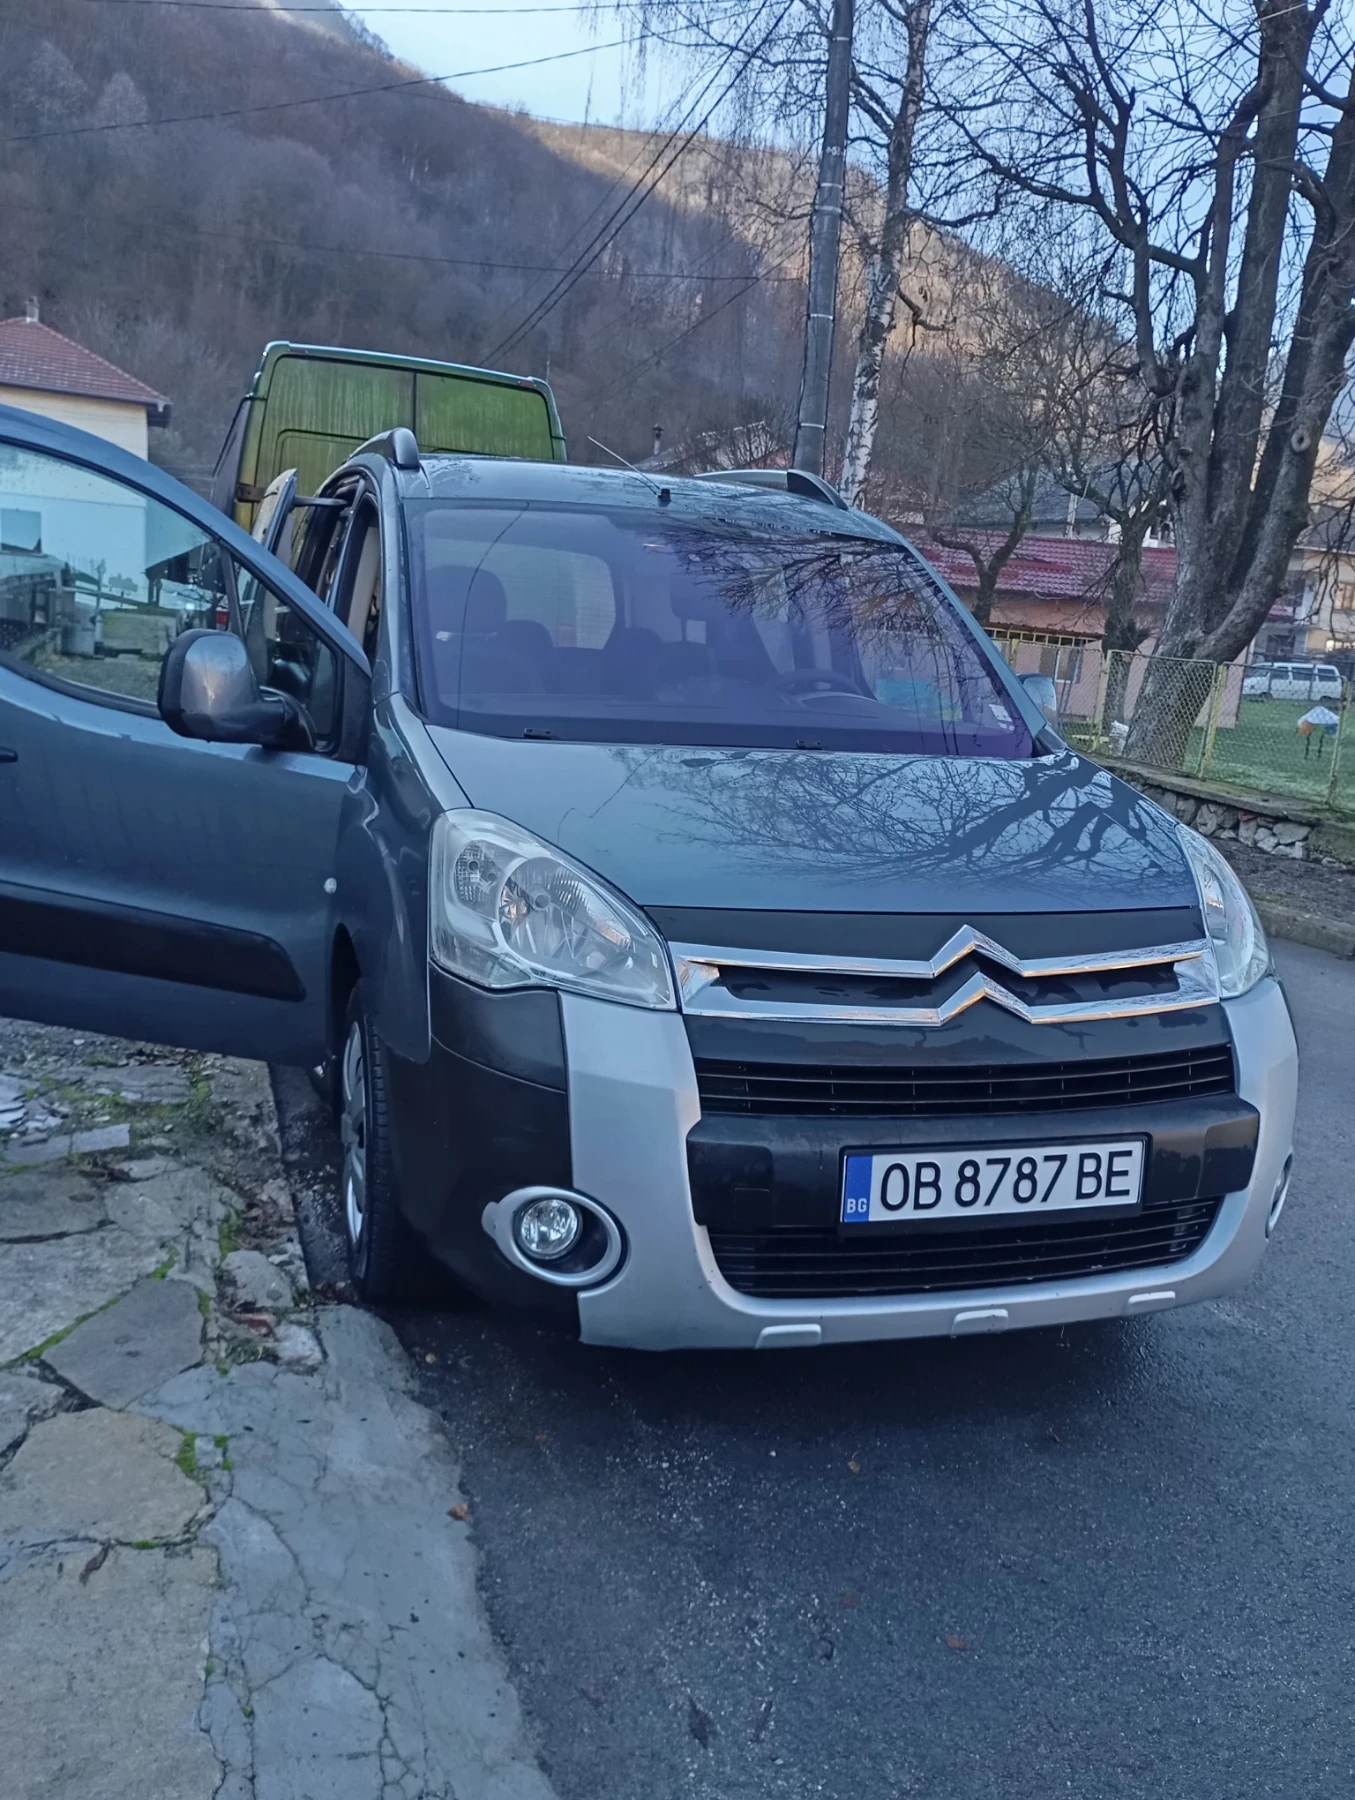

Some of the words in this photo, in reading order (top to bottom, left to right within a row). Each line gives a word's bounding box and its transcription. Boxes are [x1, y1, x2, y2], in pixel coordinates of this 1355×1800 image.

[880, 1161, 942, 1211] OB
[954, 1153, 1068, 1208] 8787
[1075, 1149, 1133, 1200] BE
[846, 1198, 868, 1214] BG
